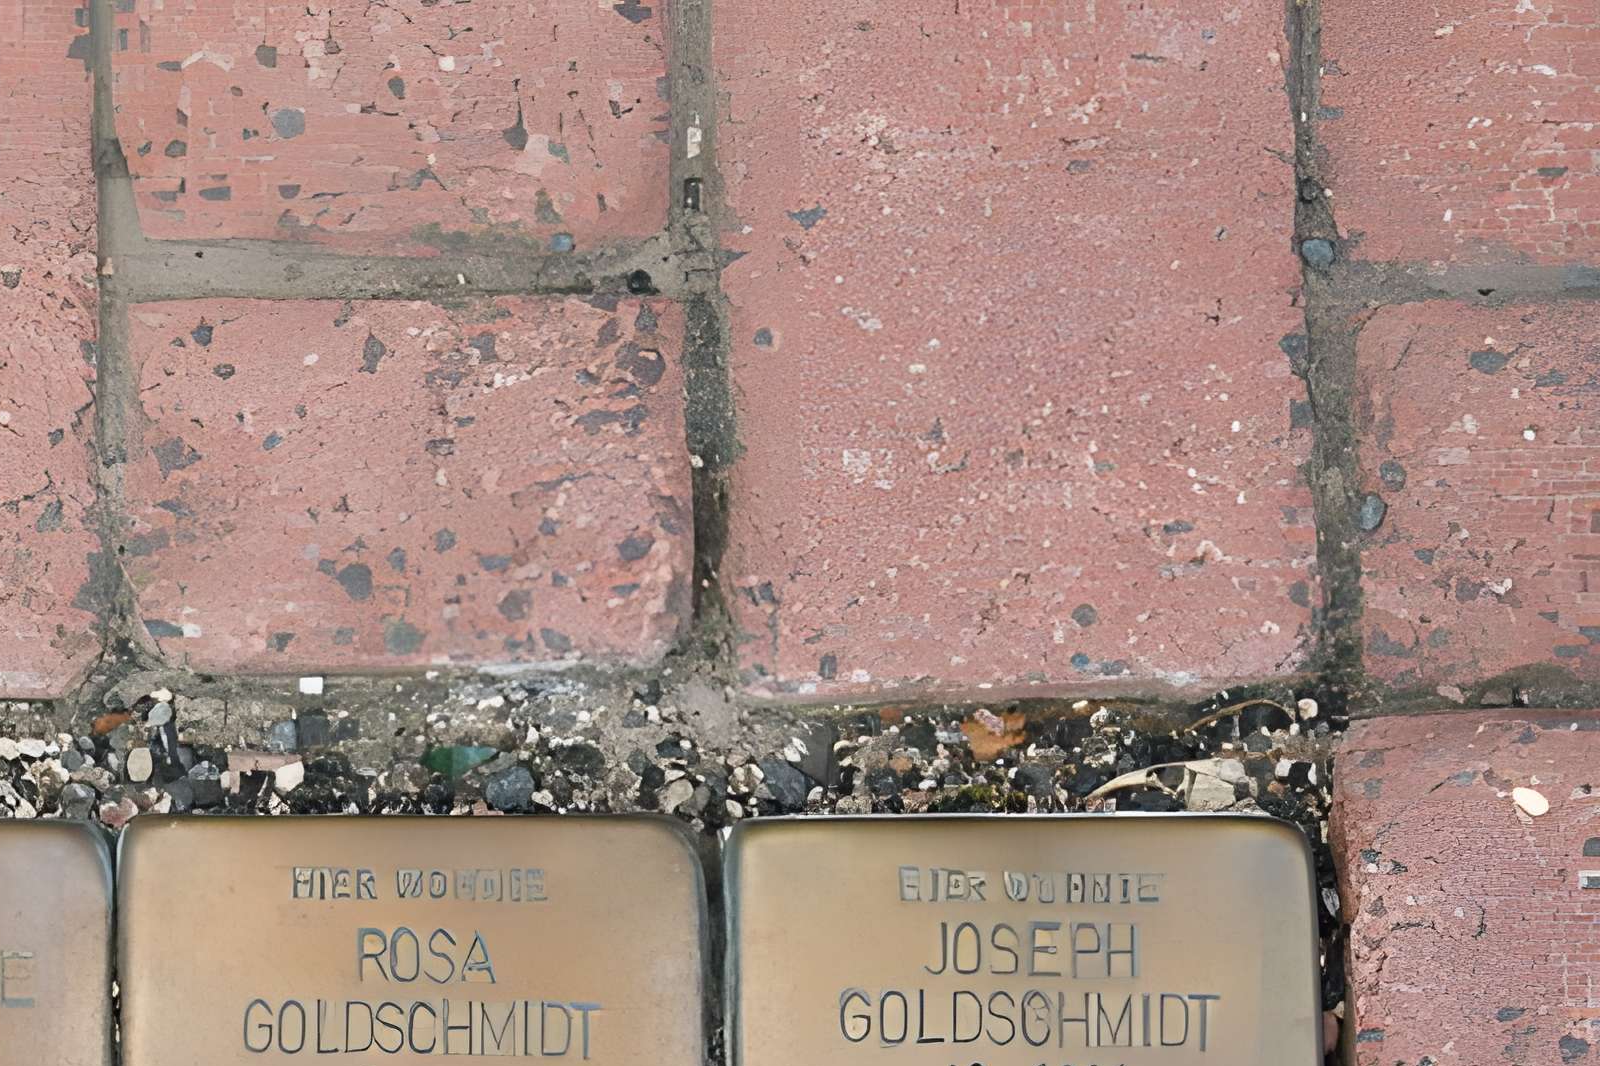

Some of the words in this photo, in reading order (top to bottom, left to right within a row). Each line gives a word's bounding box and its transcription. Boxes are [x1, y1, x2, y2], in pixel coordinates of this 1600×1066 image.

[357, 926, 496, 984] ROSA
[925, 922, 1139, 978] JOSEPH
[243, 998, 600, 1058] GOLDSCHMIDT
[839, 988, 1220, 1051] GOLDSCHMIDT
